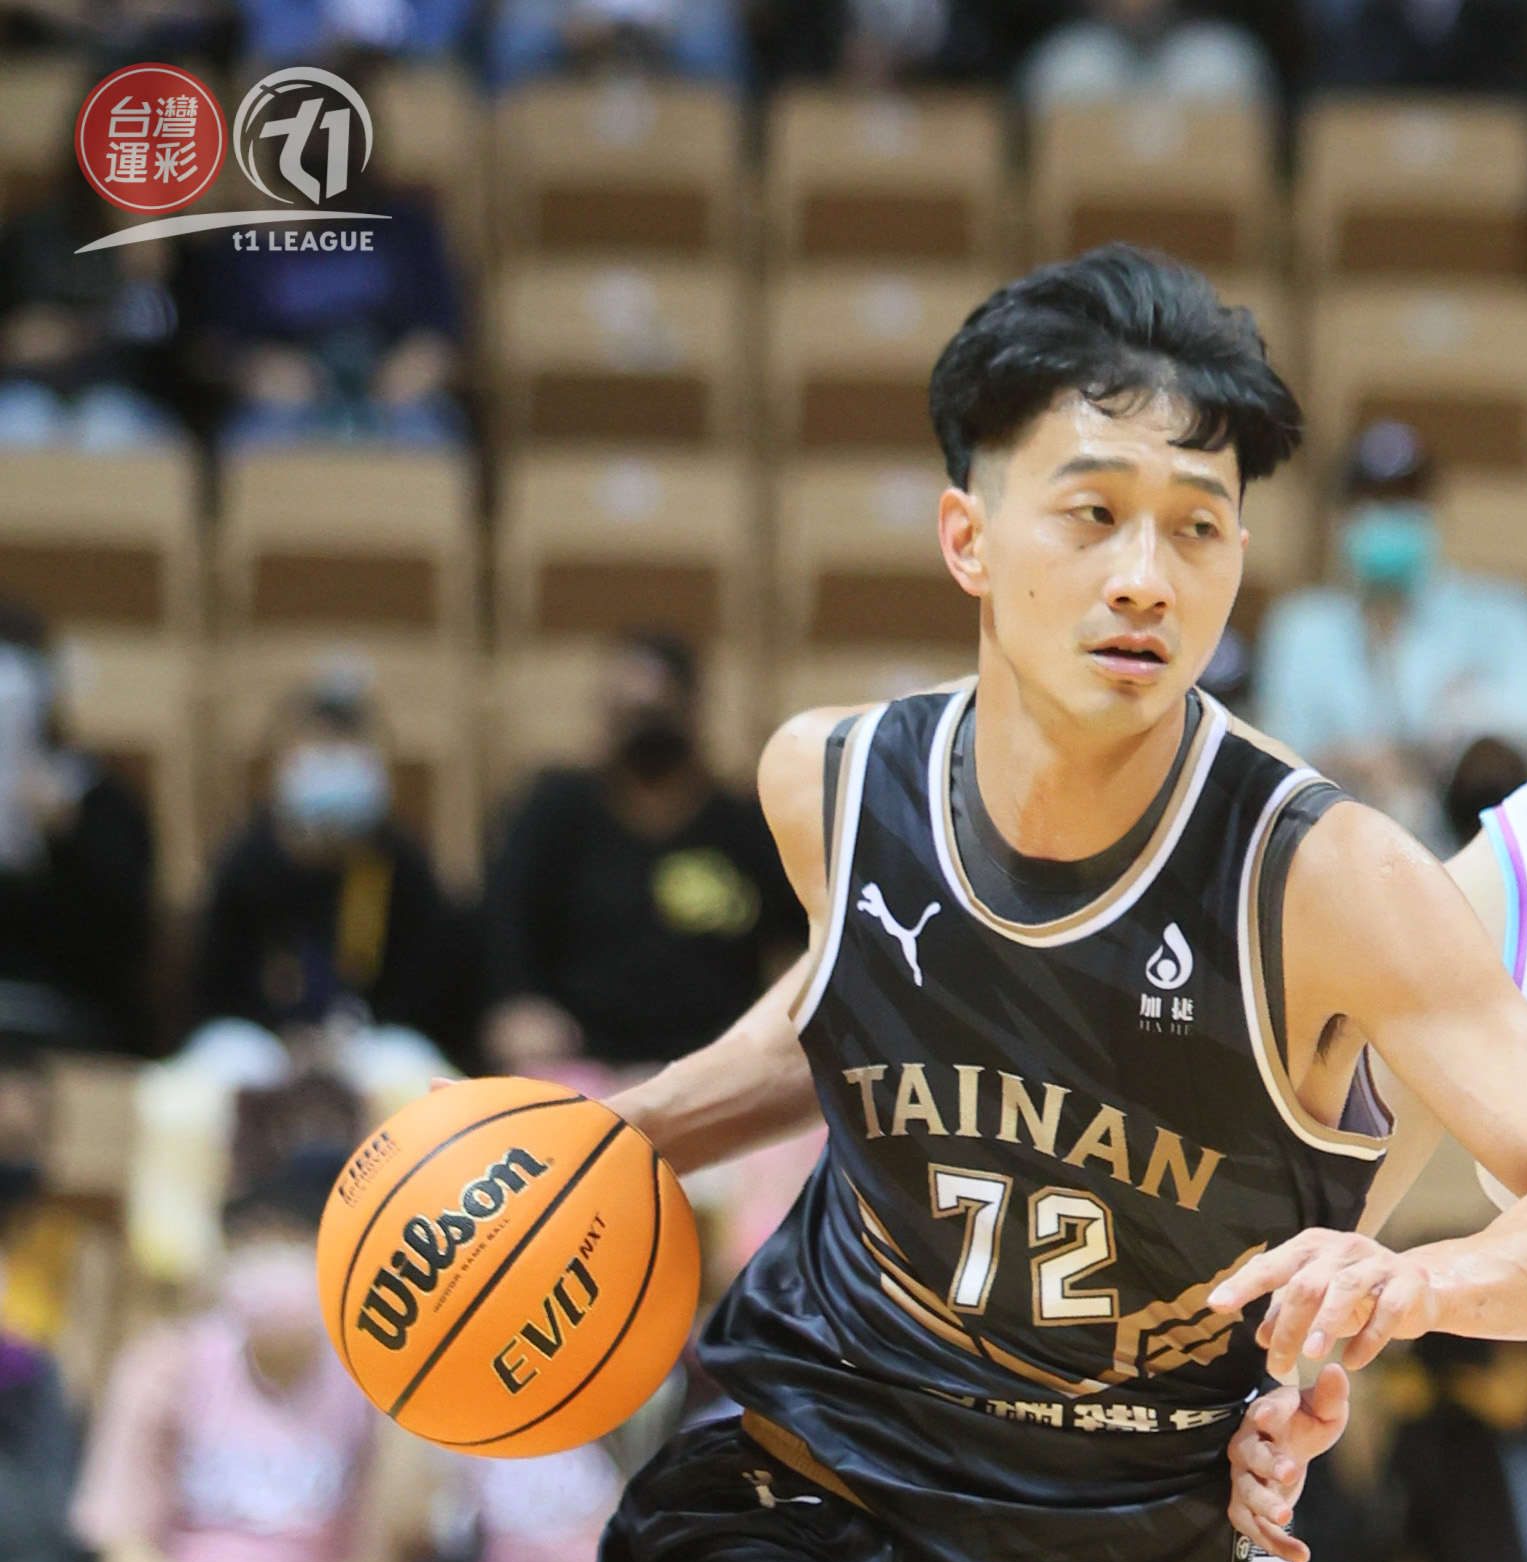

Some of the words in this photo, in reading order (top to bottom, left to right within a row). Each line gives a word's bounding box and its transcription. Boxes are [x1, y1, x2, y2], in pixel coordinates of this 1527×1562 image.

[842, 1062, 1228, 1213] TAINAN
[356, 1146, 551, 1352] Wilson
[581, 1212, 608, 1260] NXT
[928, 1162, 1120, 1327] 72
